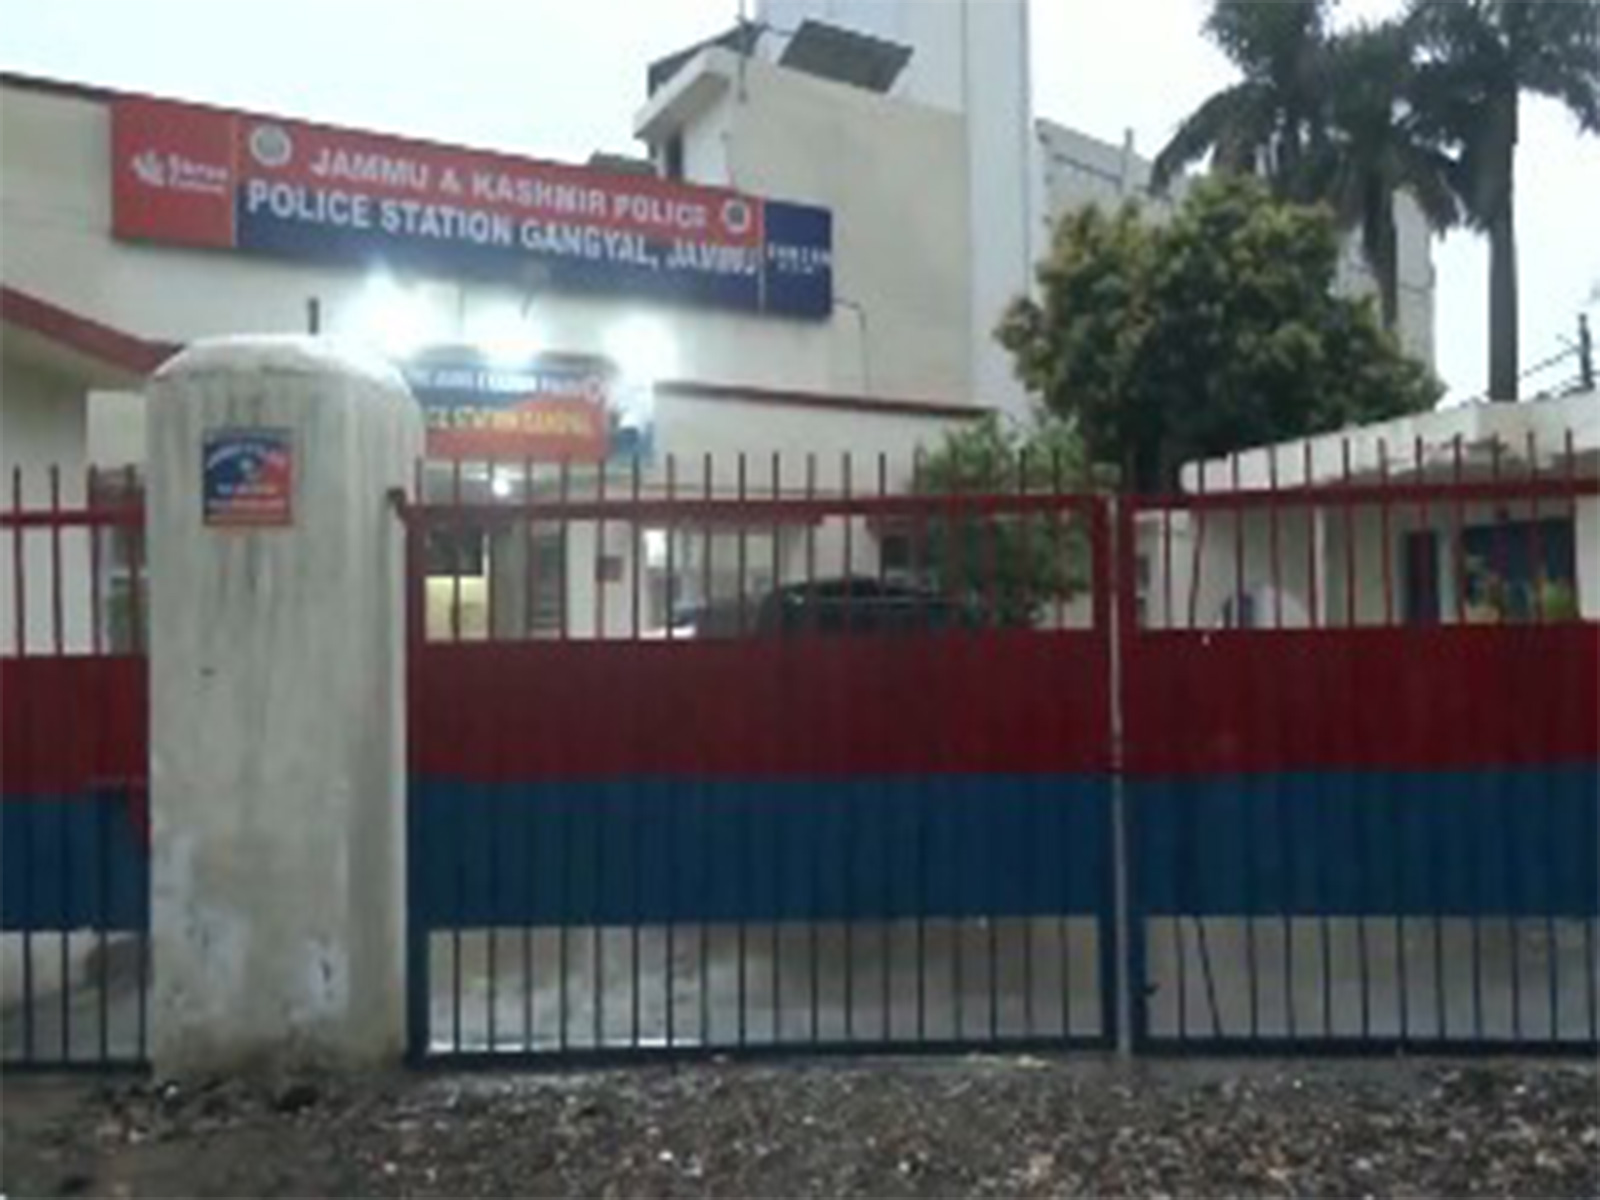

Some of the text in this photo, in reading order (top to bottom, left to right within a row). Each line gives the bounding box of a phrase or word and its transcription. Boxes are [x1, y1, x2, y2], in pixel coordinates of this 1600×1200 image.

[247, 179, 371, 228] POLICE
[380, 200, 511, 246] STATION
[520, 222, 658, 272] GANGYAL,
[311, 149, 428, 189] JAMMU
[472, 173, 606, 217] KASHMIR
[614, 193, 708, 228] POLICE
